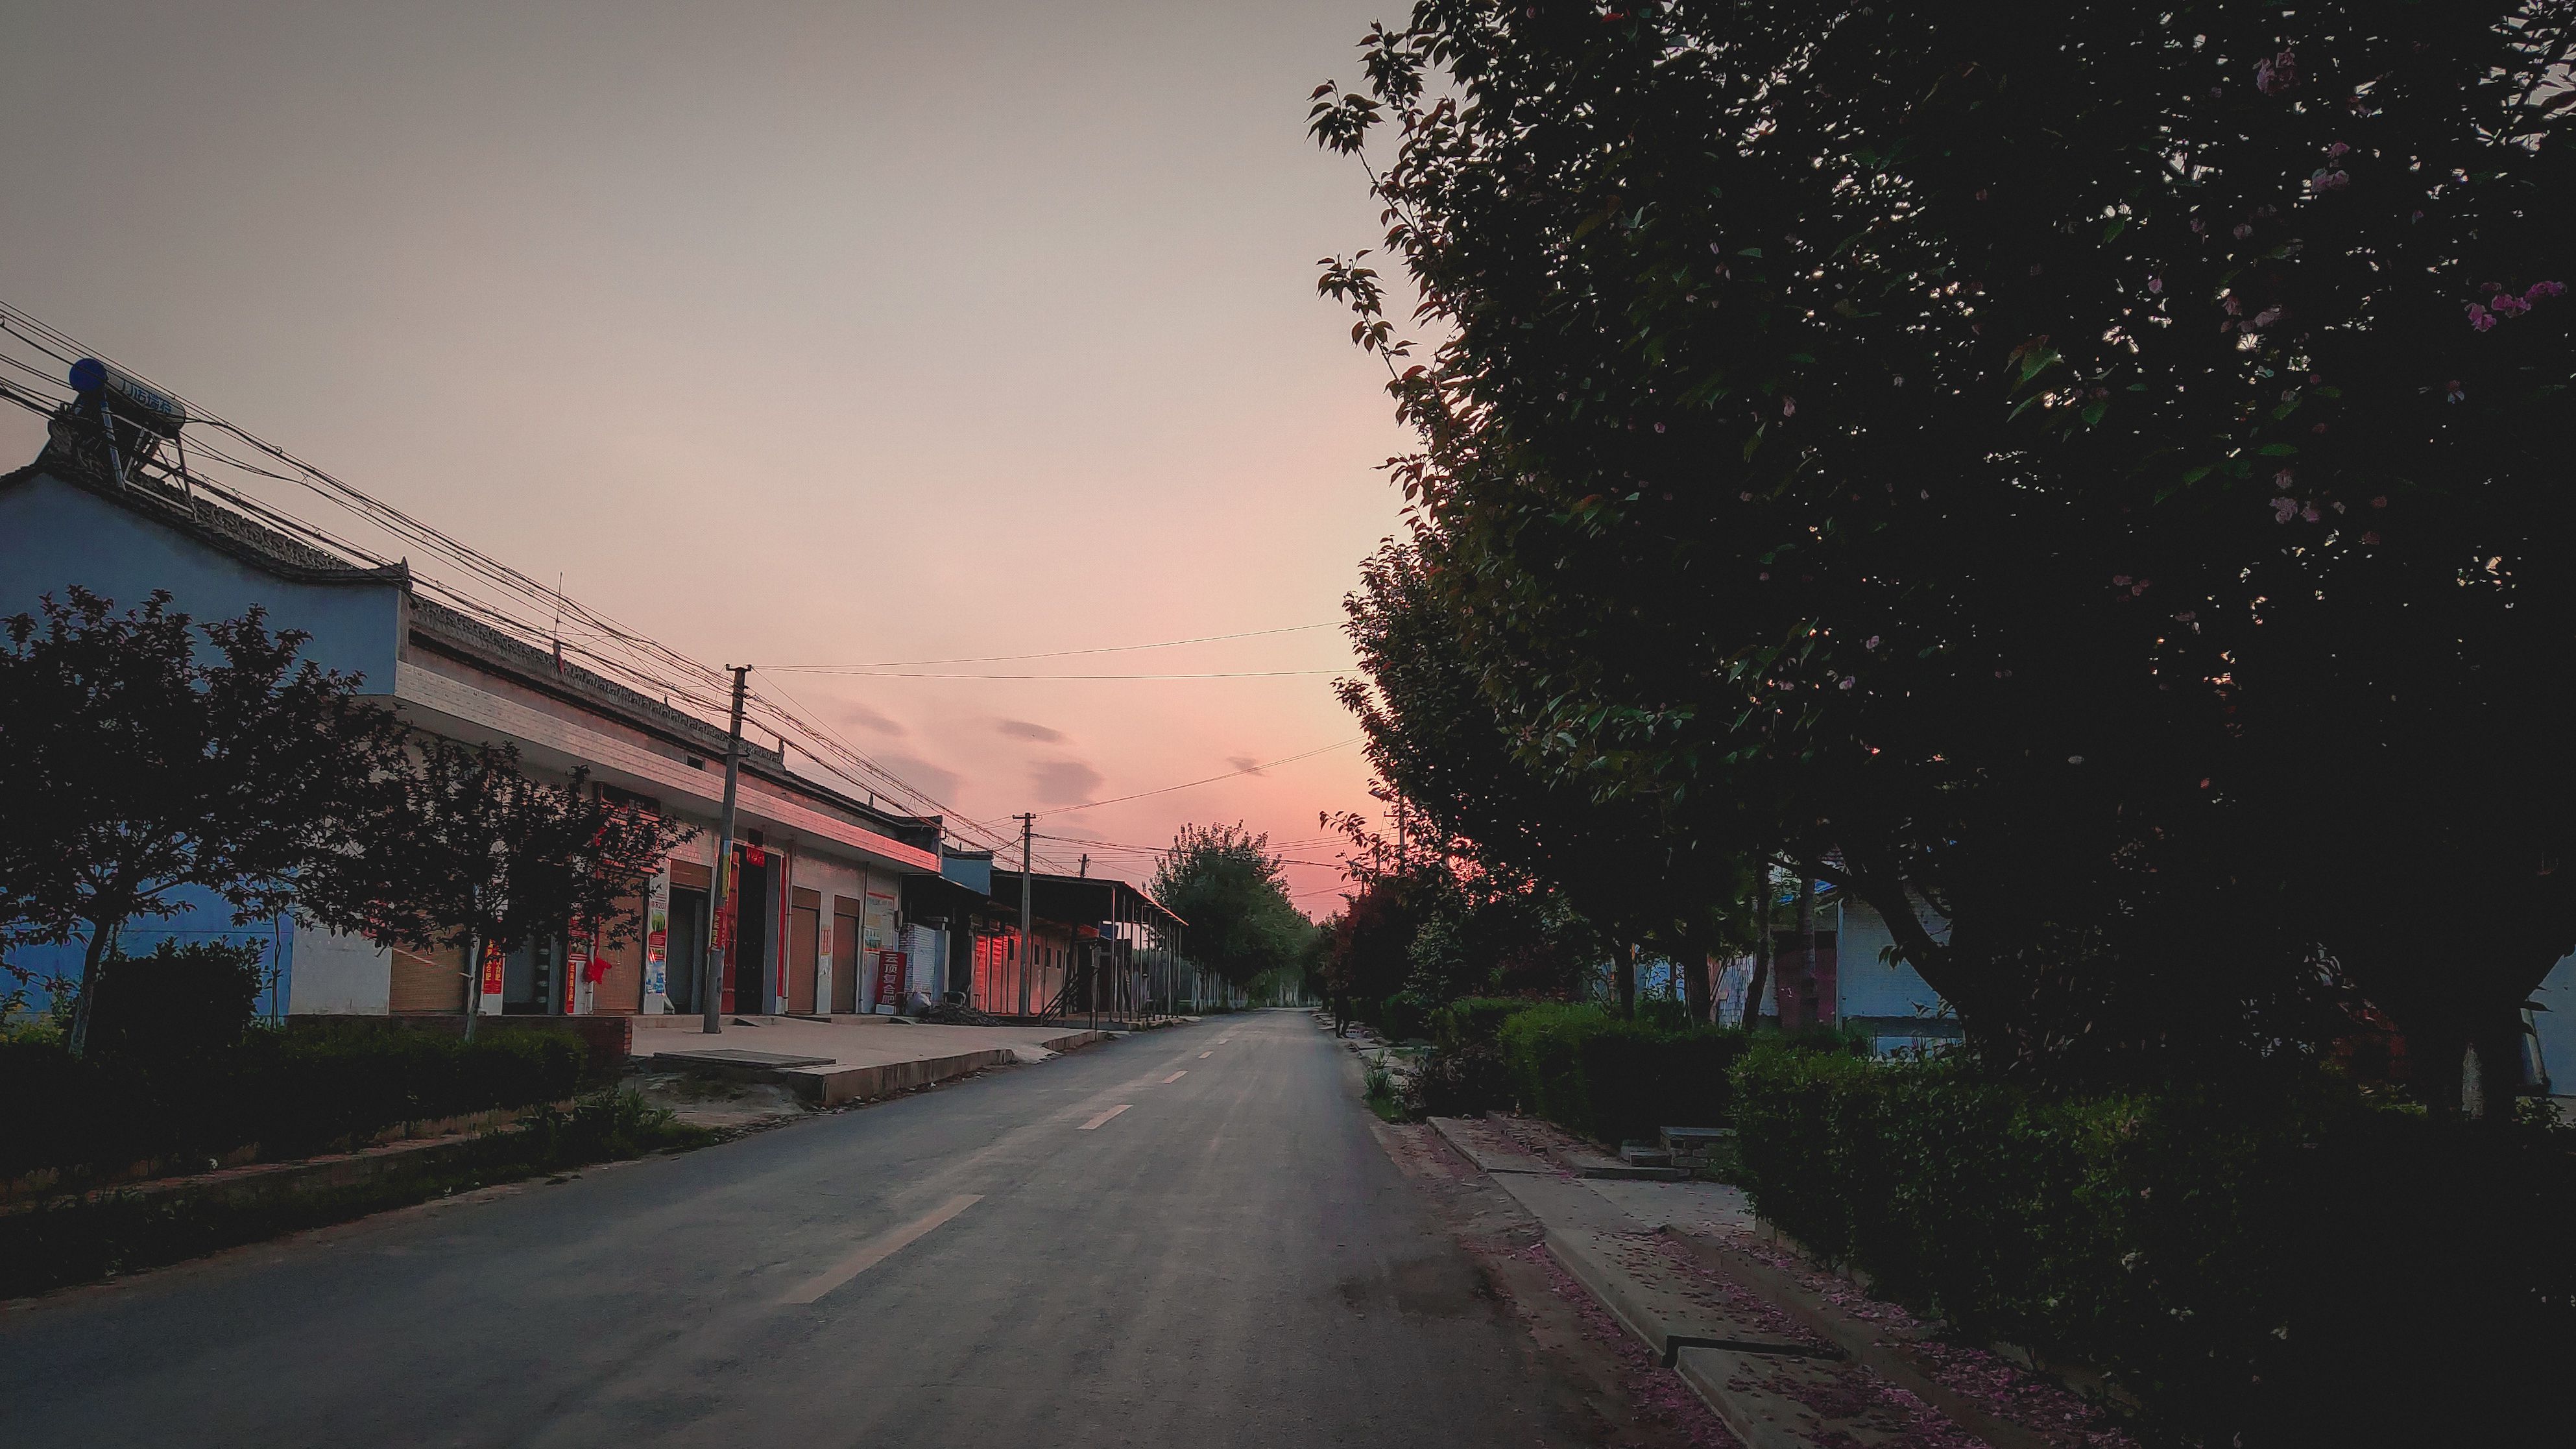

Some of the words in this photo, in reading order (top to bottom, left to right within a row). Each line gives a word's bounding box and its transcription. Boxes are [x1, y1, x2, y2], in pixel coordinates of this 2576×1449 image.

[882, 953, 898, 1005] 云顶复合肥
